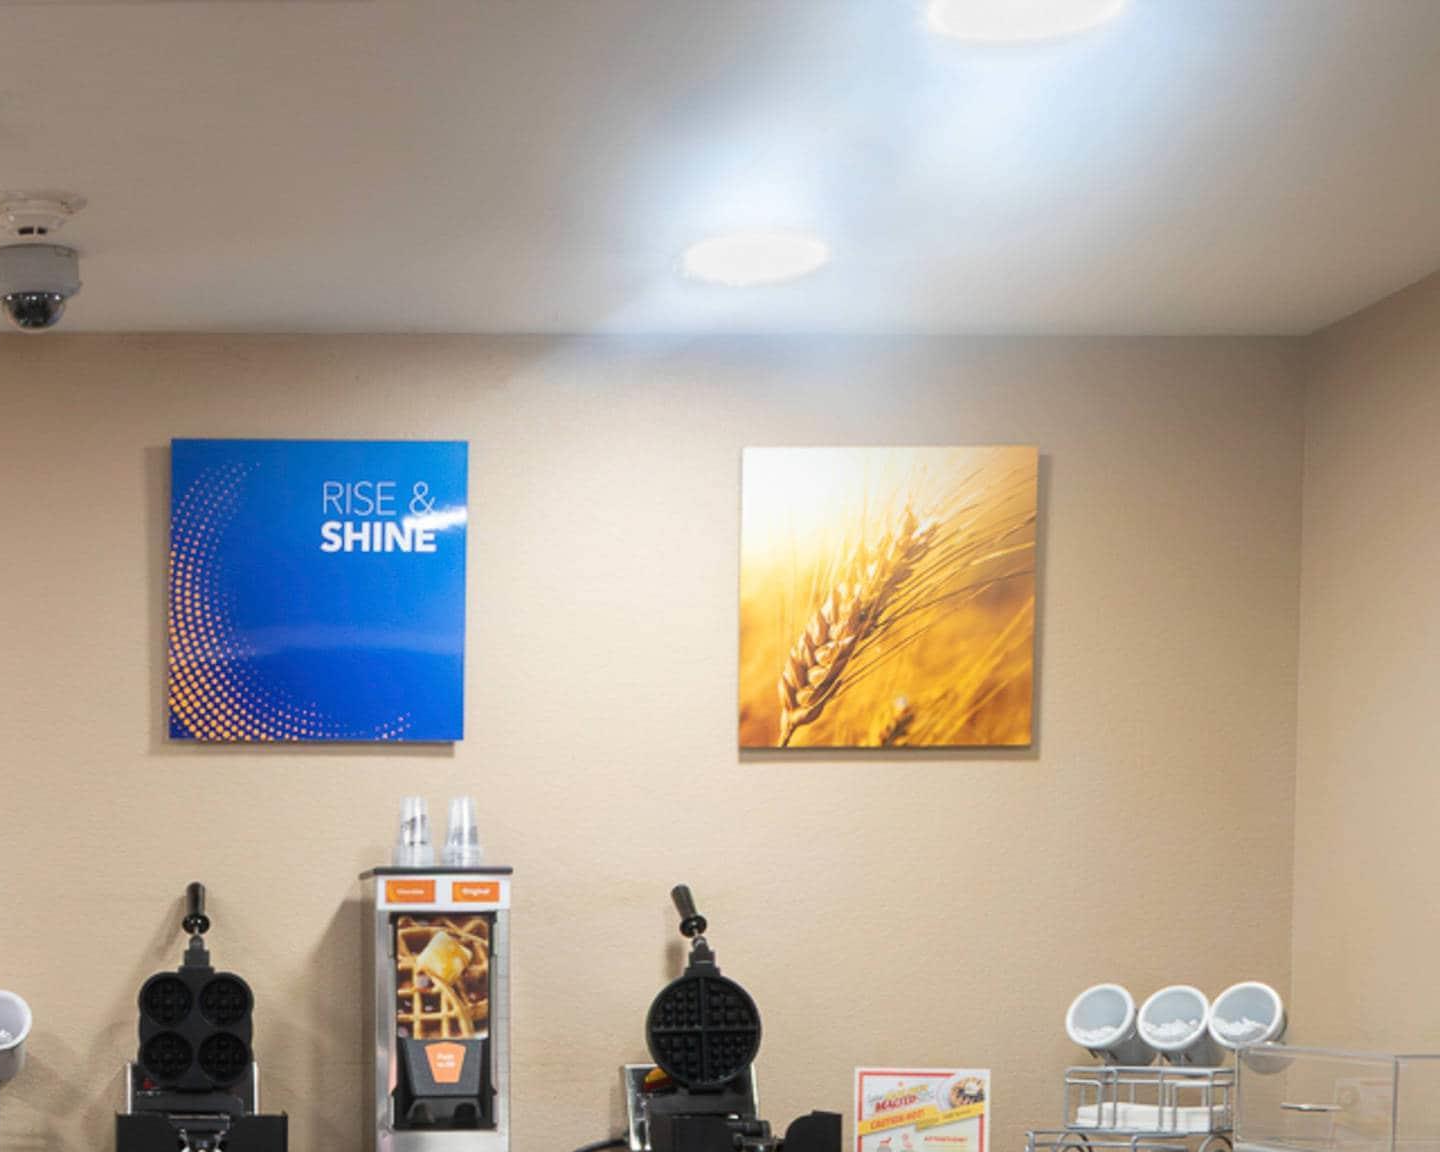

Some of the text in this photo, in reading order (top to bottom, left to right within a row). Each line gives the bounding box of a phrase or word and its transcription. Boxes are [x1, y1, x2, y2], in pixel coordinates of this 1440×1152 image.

[322, 480, 436, 516] RISE &
[320, 520, 437, 553] SHINE
